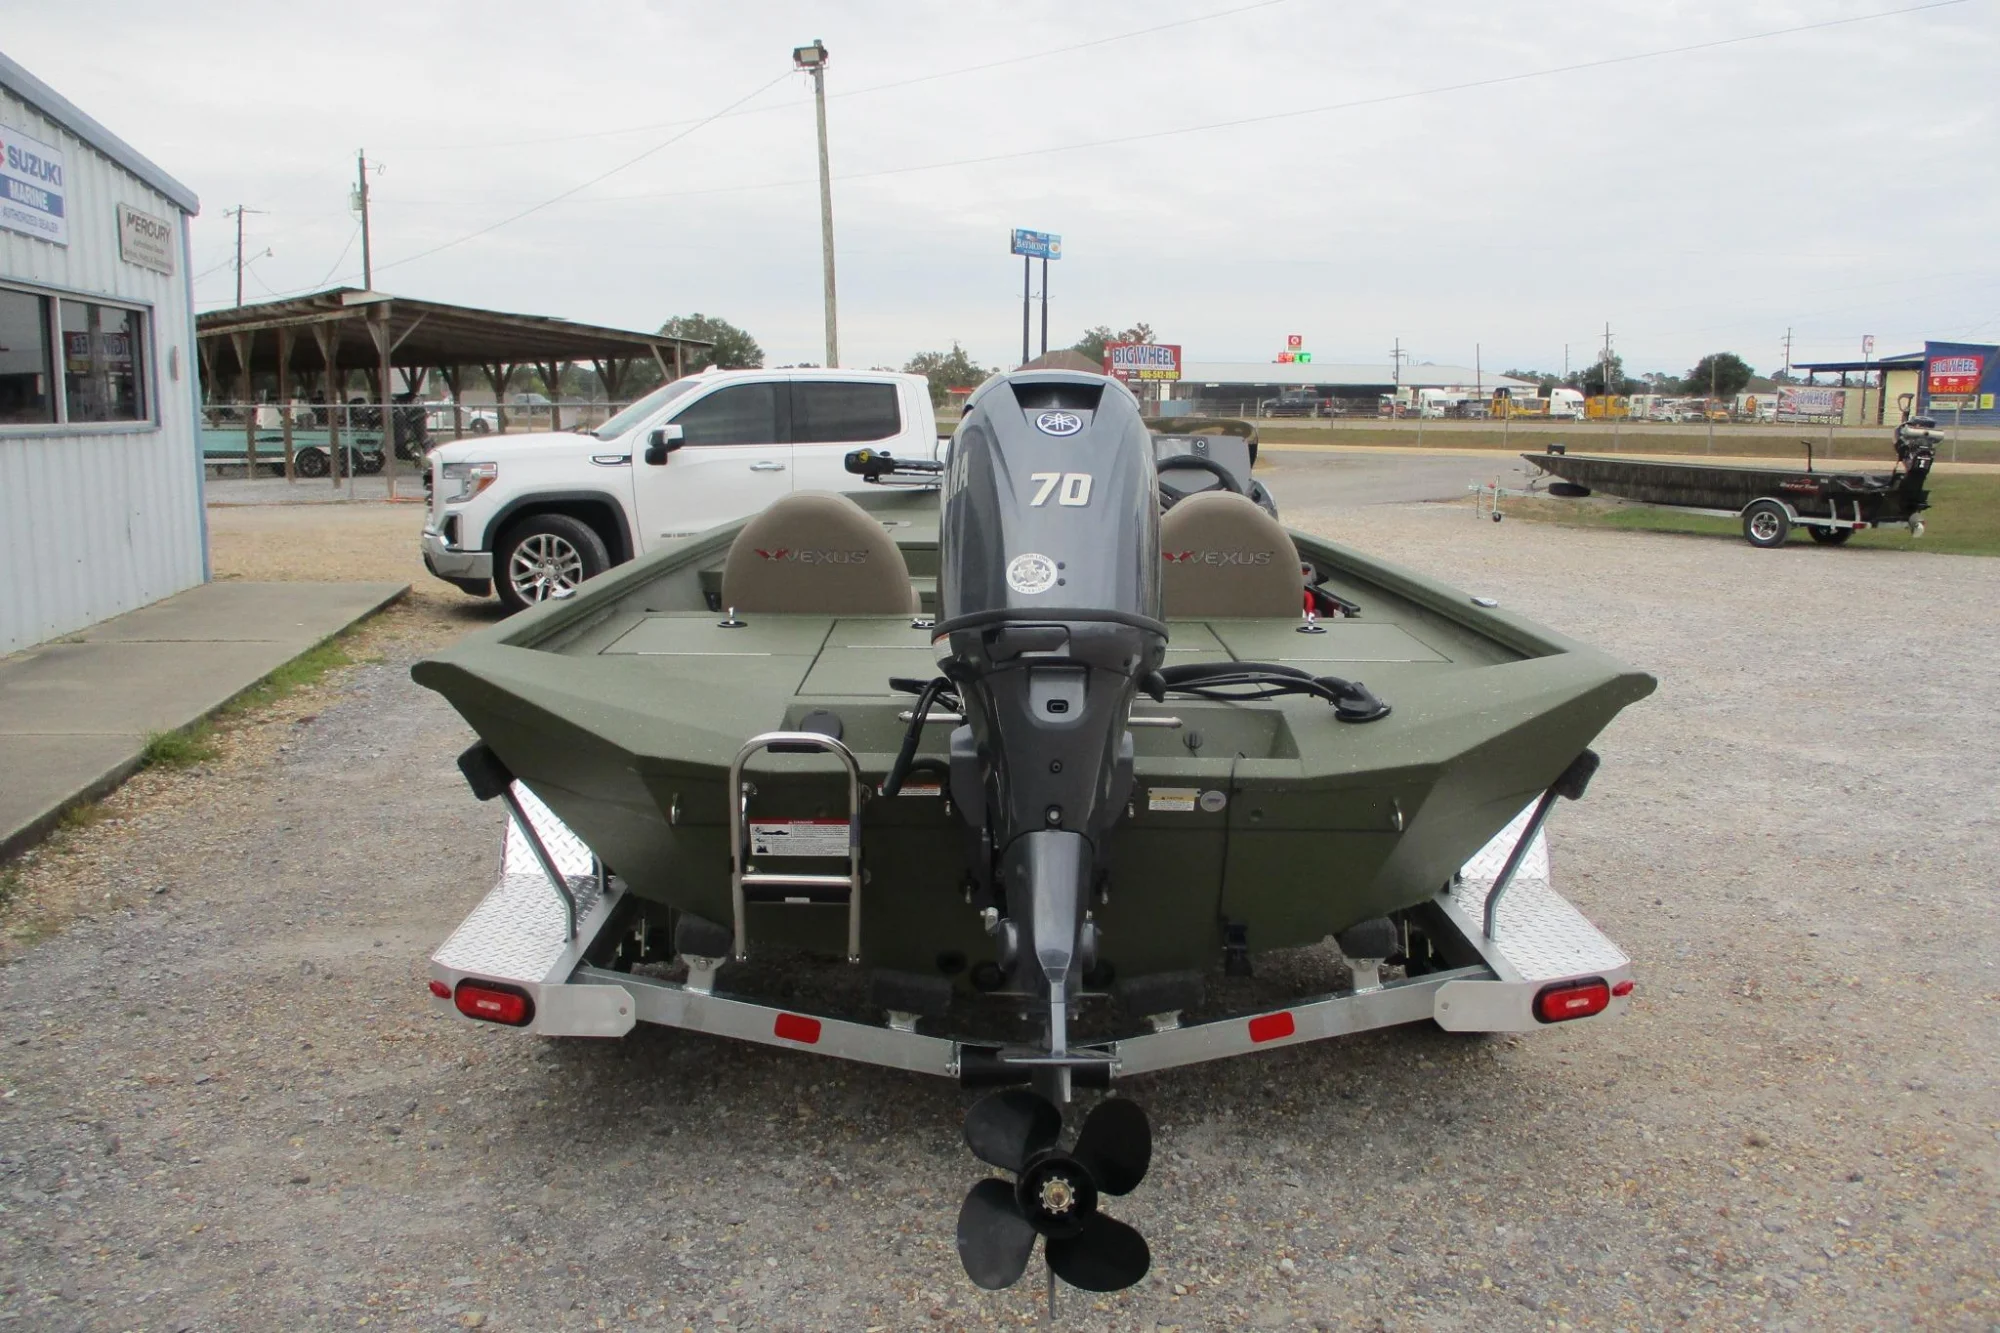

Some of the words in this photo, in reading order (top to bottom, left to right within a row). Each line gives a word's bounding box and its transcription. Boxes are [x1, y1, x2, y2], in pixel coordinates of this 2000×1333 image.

[8, 145, 62, 187] SUZUKI
[9, 179, 49, 211] MARINE
[126, 212, 172, 244] MERCURY
[1113, 346, 1135, 364] BIG
[1136, 345, 1175, 366] WHEEL
[1949, 357, 1978, 372] WHEEL
[1029, 472, 1093, 507] 70
[785, 547, 868, 565] VEXUS
[1190, 548, 1271, 566] VEXUS
